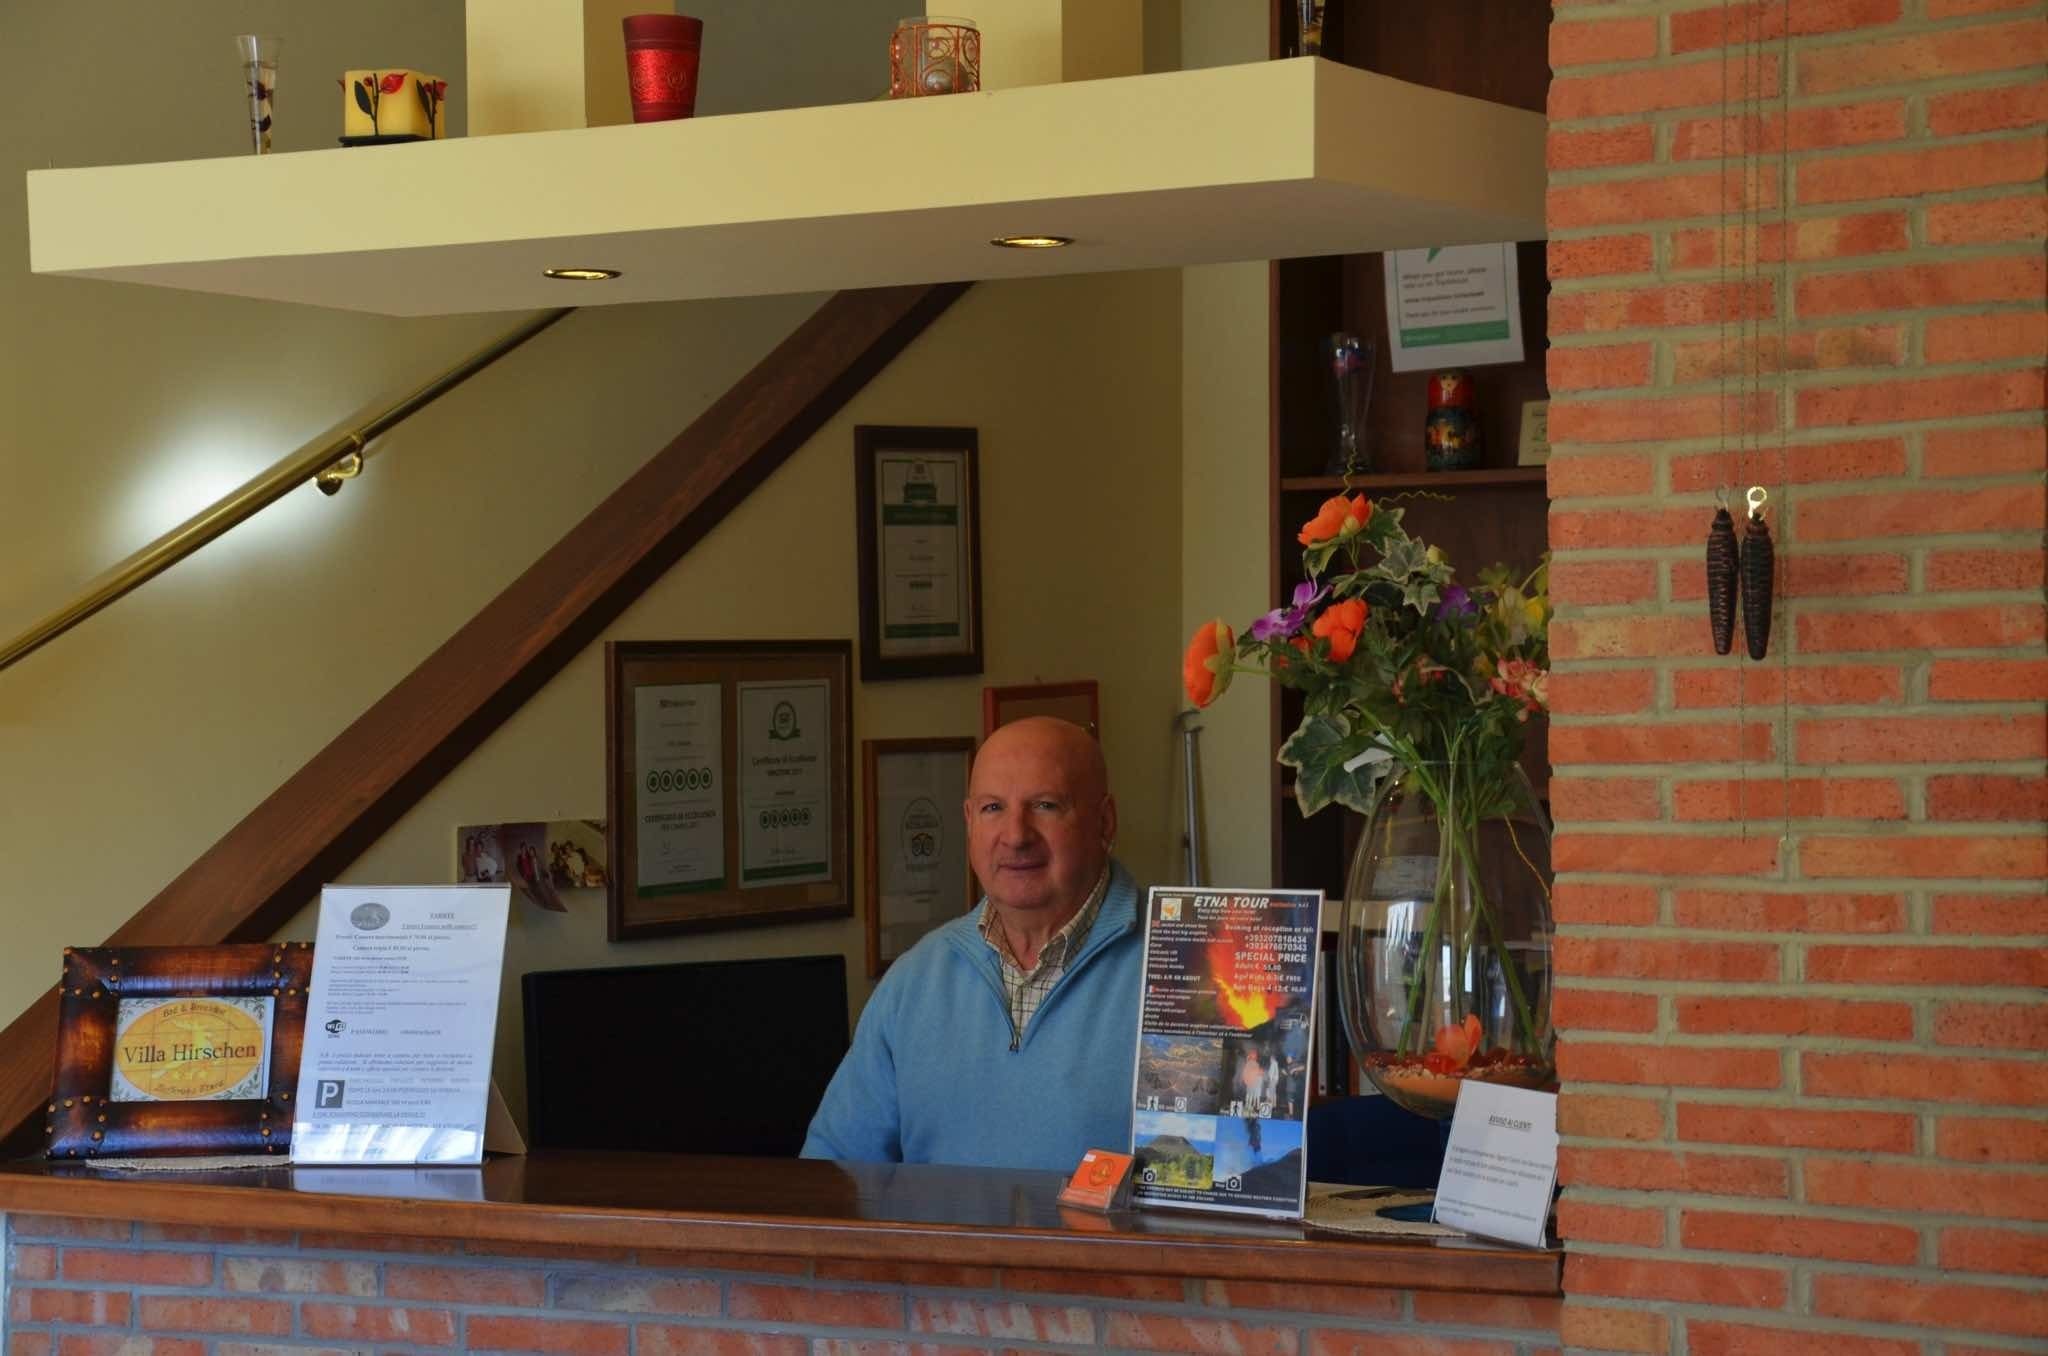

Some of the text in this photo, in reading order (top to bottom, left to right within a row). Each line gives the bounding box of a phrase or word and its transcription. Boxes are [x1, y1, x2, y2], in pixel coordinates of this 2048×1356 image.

[1193, 896, 1228, 908] ETNA
[1233, 897, 1270, 909] TOUR
[1225, 924, 1251, 933] Booking
[1234, 952, 1307, 963] SPECIAL PRICE
[123, 1041, 257, 1064] Villa Hirschen
